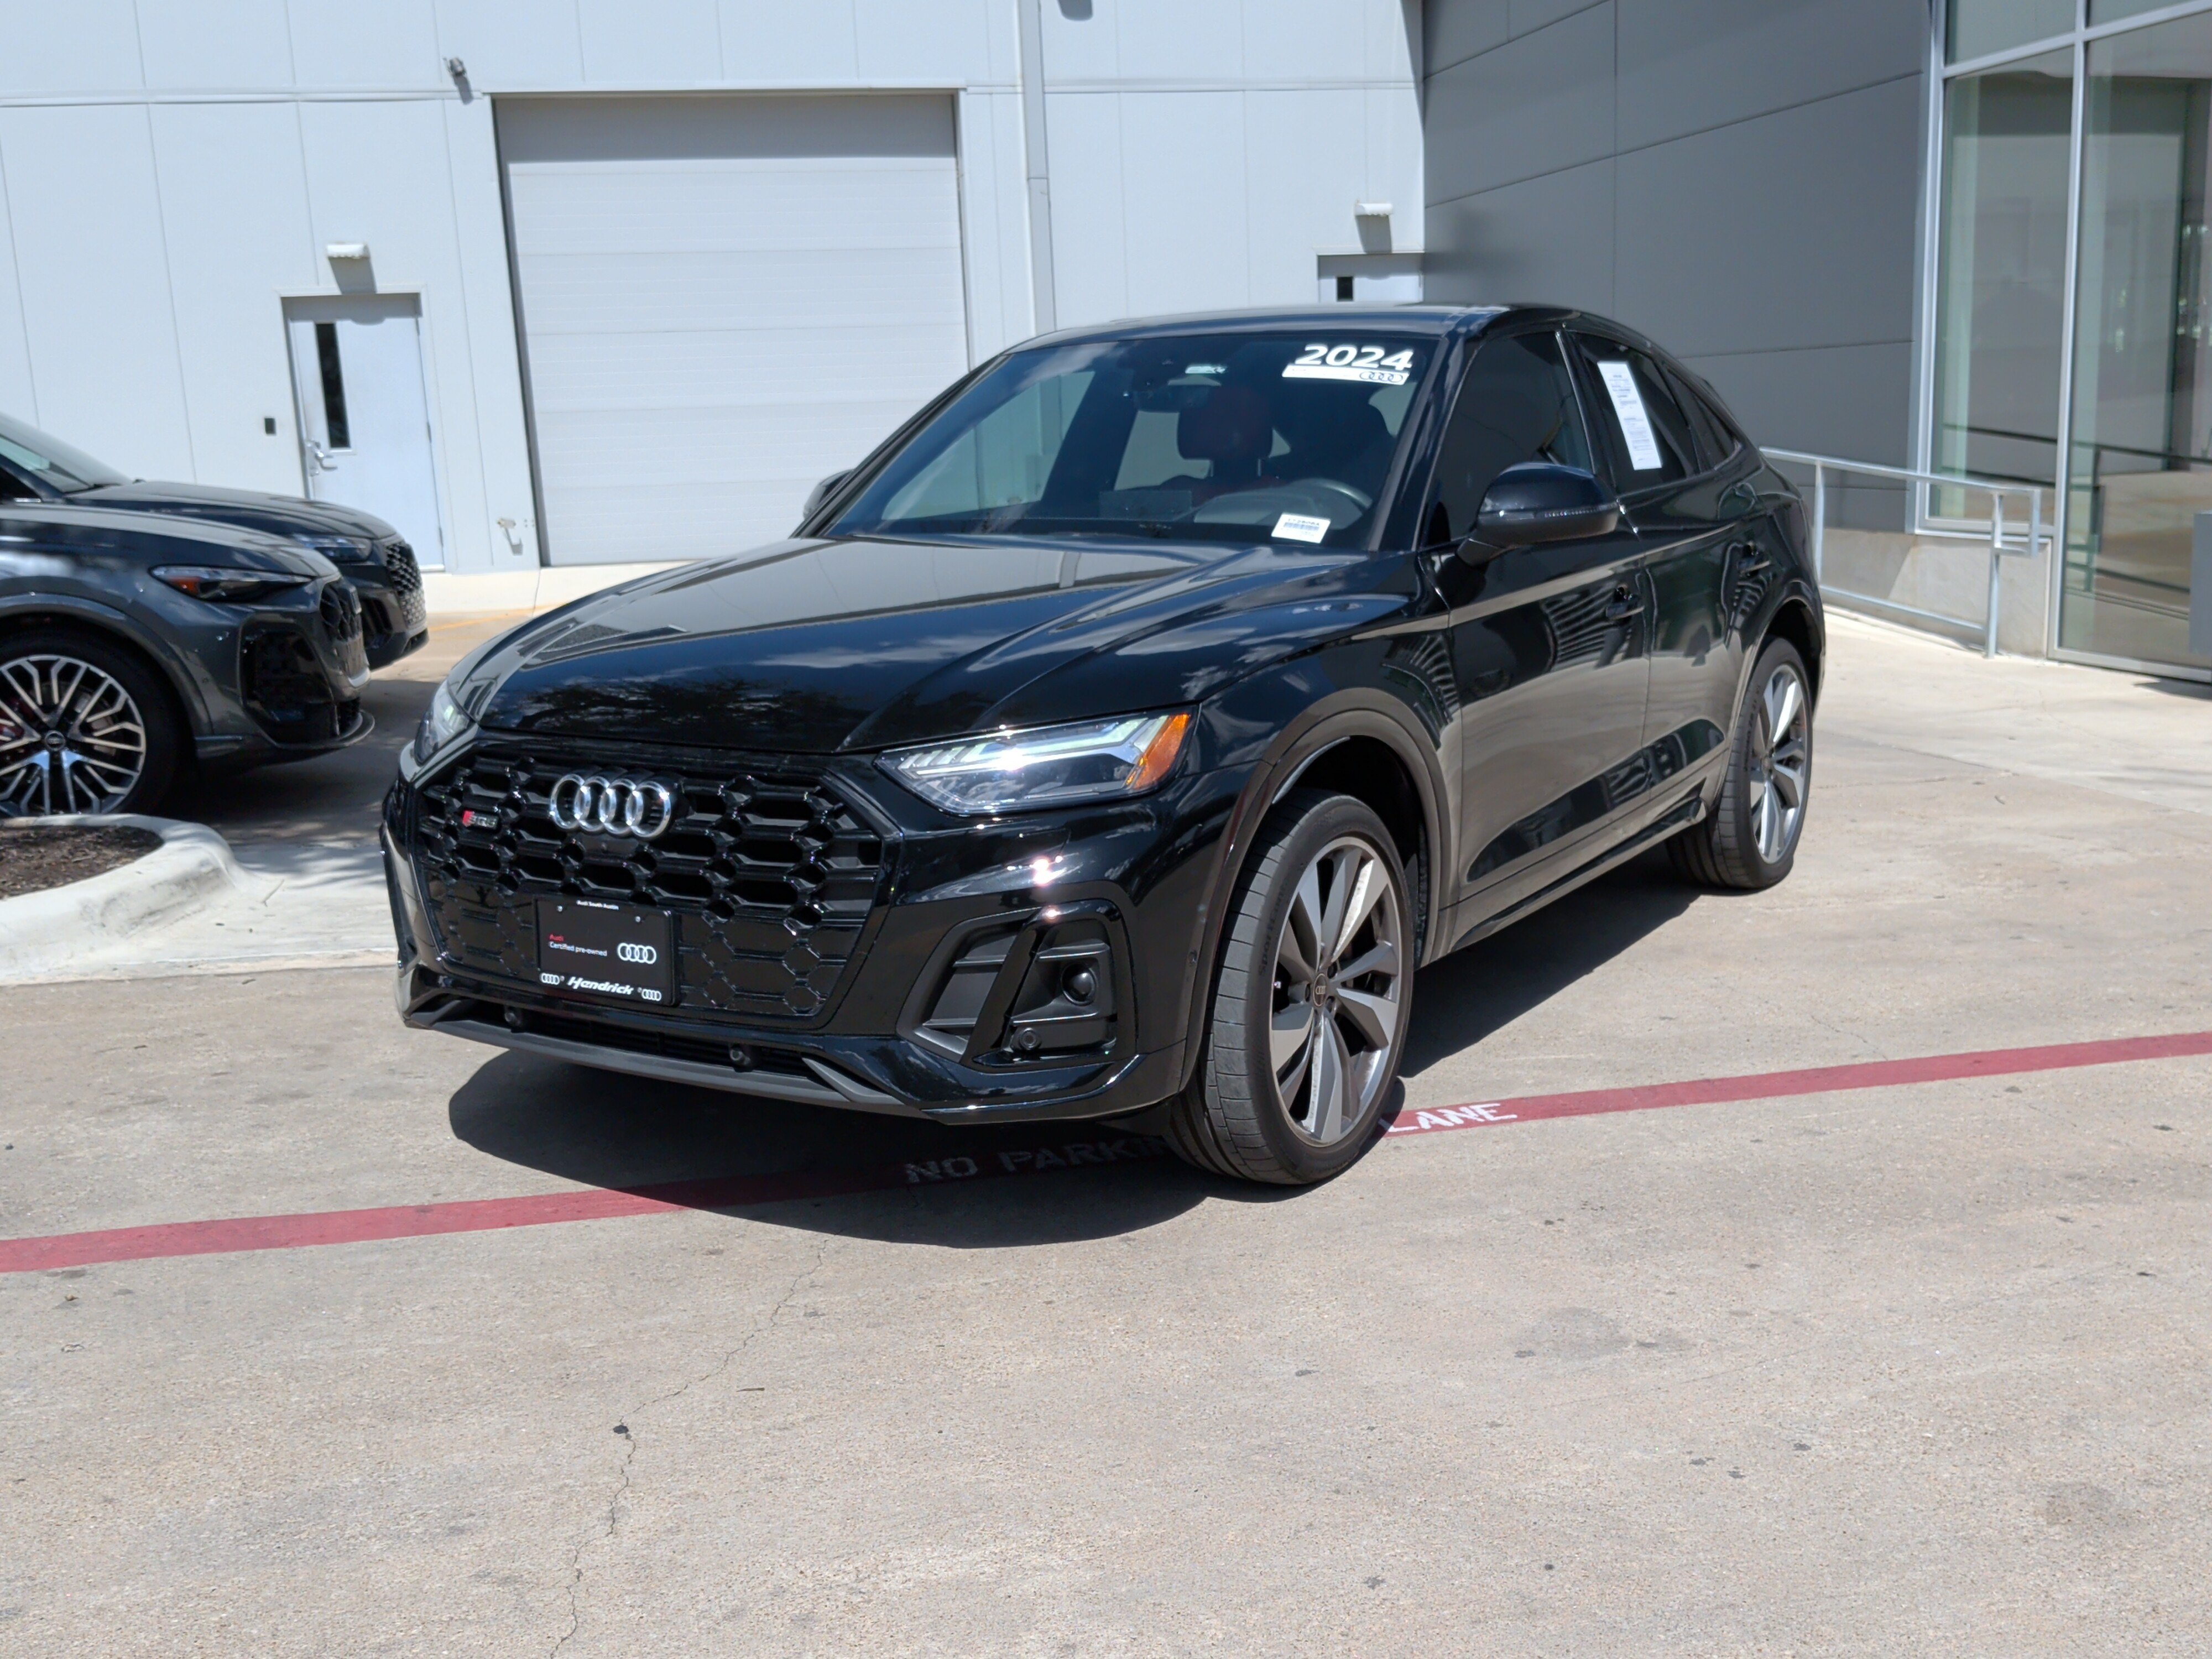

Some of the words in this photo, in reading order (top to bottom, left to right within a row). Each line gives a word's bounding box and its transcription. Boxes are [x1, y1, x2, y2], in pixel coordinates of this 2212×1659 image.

[1295, 345, 1414, 371] 2024
[549, 941, 575, 952] Certified
[575, 946, 607, 957] pre-owned
[567, 976, 634, 995] Hendrick
[905, 1157, 978, 1183] NO
[1378, 1103, 1518, 1133] LANE
